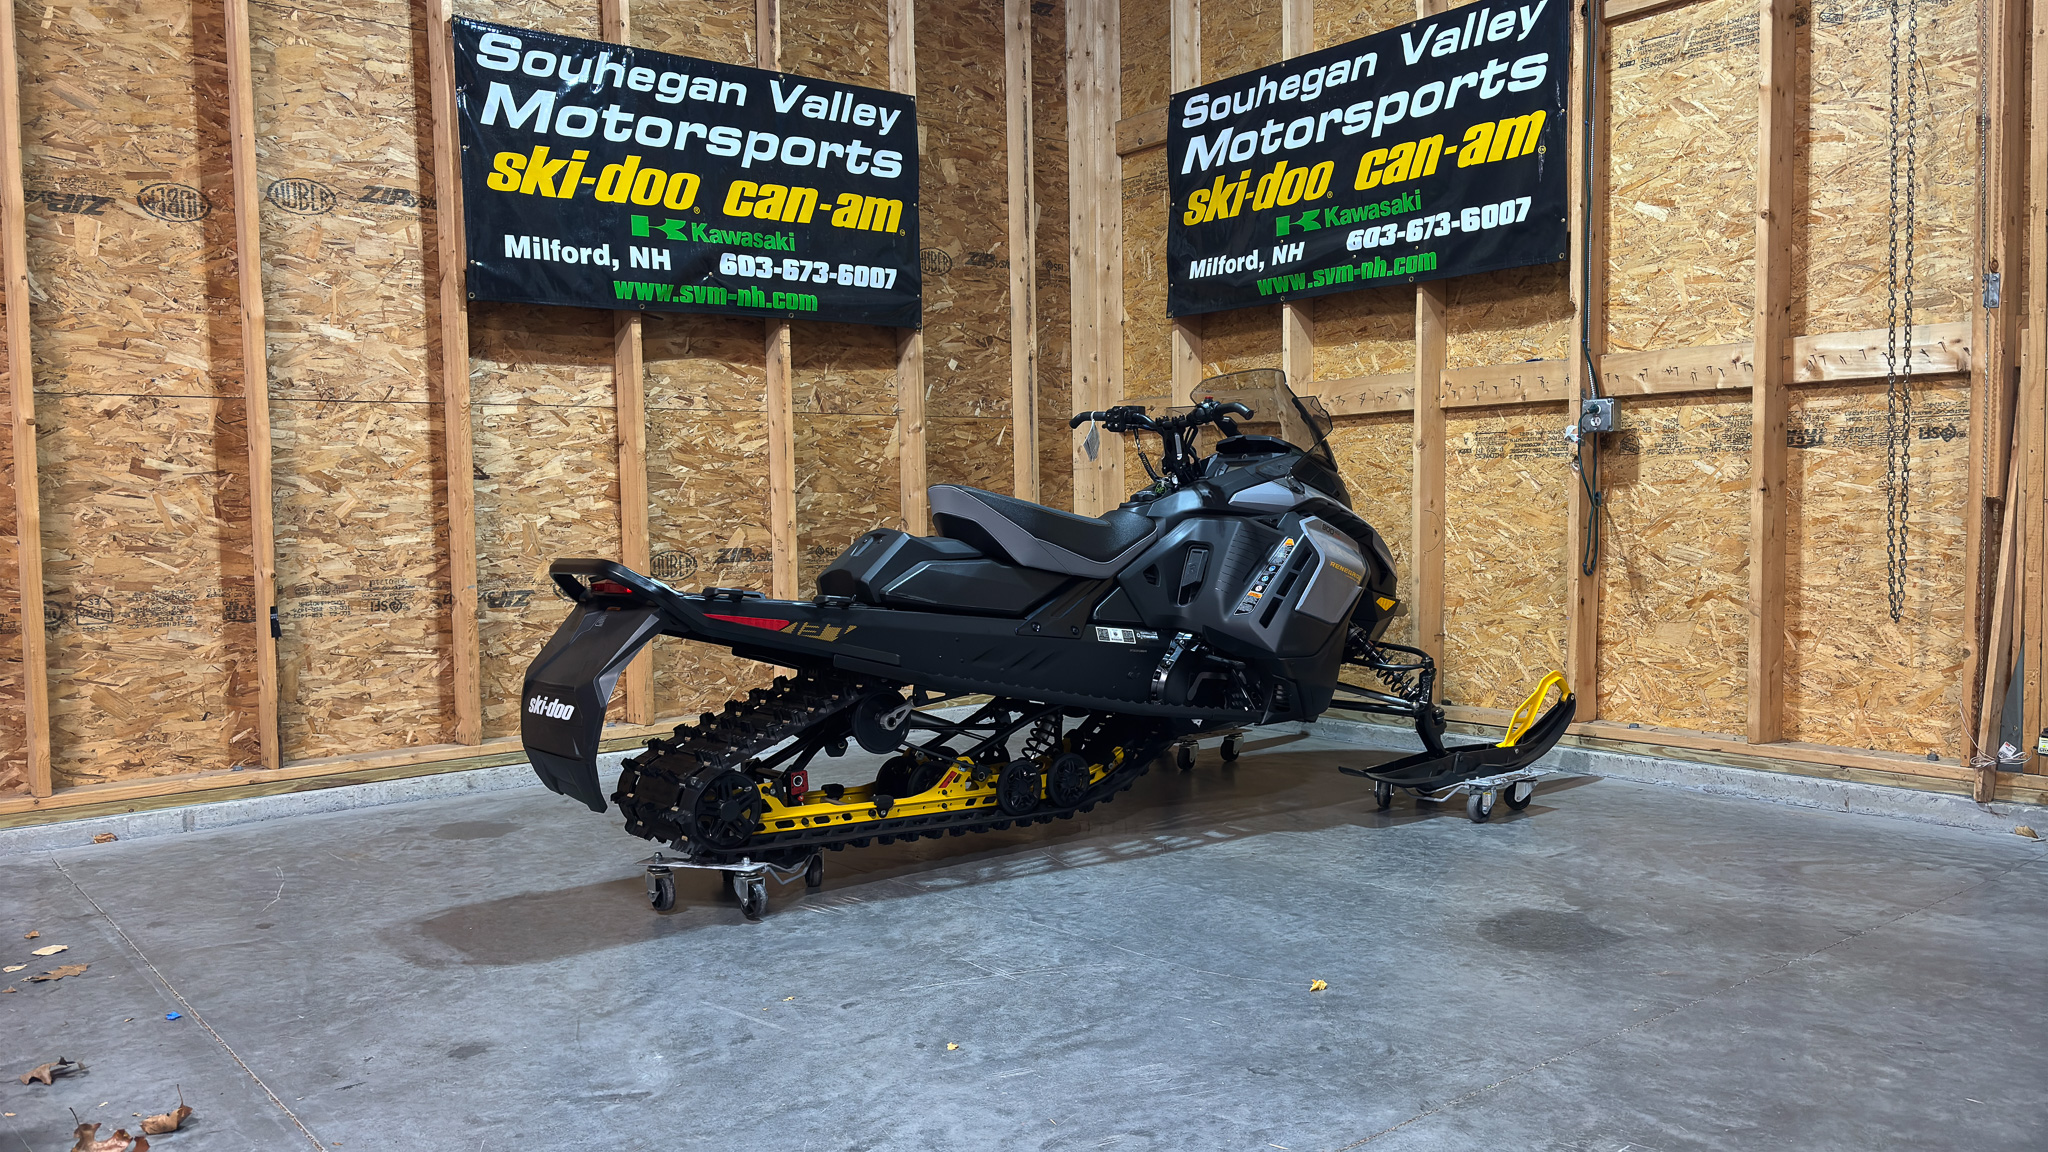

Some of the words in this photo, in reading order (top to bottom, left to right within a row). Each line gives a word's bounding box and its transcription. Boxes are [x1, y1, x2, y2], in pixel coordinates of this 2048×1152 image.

[1182, 52, 1379, 128] Souhegan
[1400, 0, 1549, 66] Valley
[476, 32, 747, 106] Souhegan
[770, 80, 901, 136] Valley
[480, 82, 903, 179] Motorsports
[1181, 53, 1549, 175] Motorsports
[273, 181, 332, 212] HUBER
[357, 185, 410, 206] ZIP
[1324, 189, 1422, 228] Kawasaki
[691, 222, 796, 251] Kawasaki
[1346, 197, 1532, 252] 603-673-6007
[504, 234, 619, 271] Milford,
[629, 246, 671, 270] NH
[719, 252, 897, 290] 603-673-6007
[1189, 248, 1265, 280] Milford,
[1271, 241, 1305, 266] NH
[1257, 249, 1437, 297] www.svm-nh.com
[613, 279, 819, 312] www.svm-nh.com
[653, 554, 697, 577] HUBER
[714, 547, 752, 564] ZIP
[370, 600, 388, 612] SFI
[528, 694, 575, 721] ski-doo
